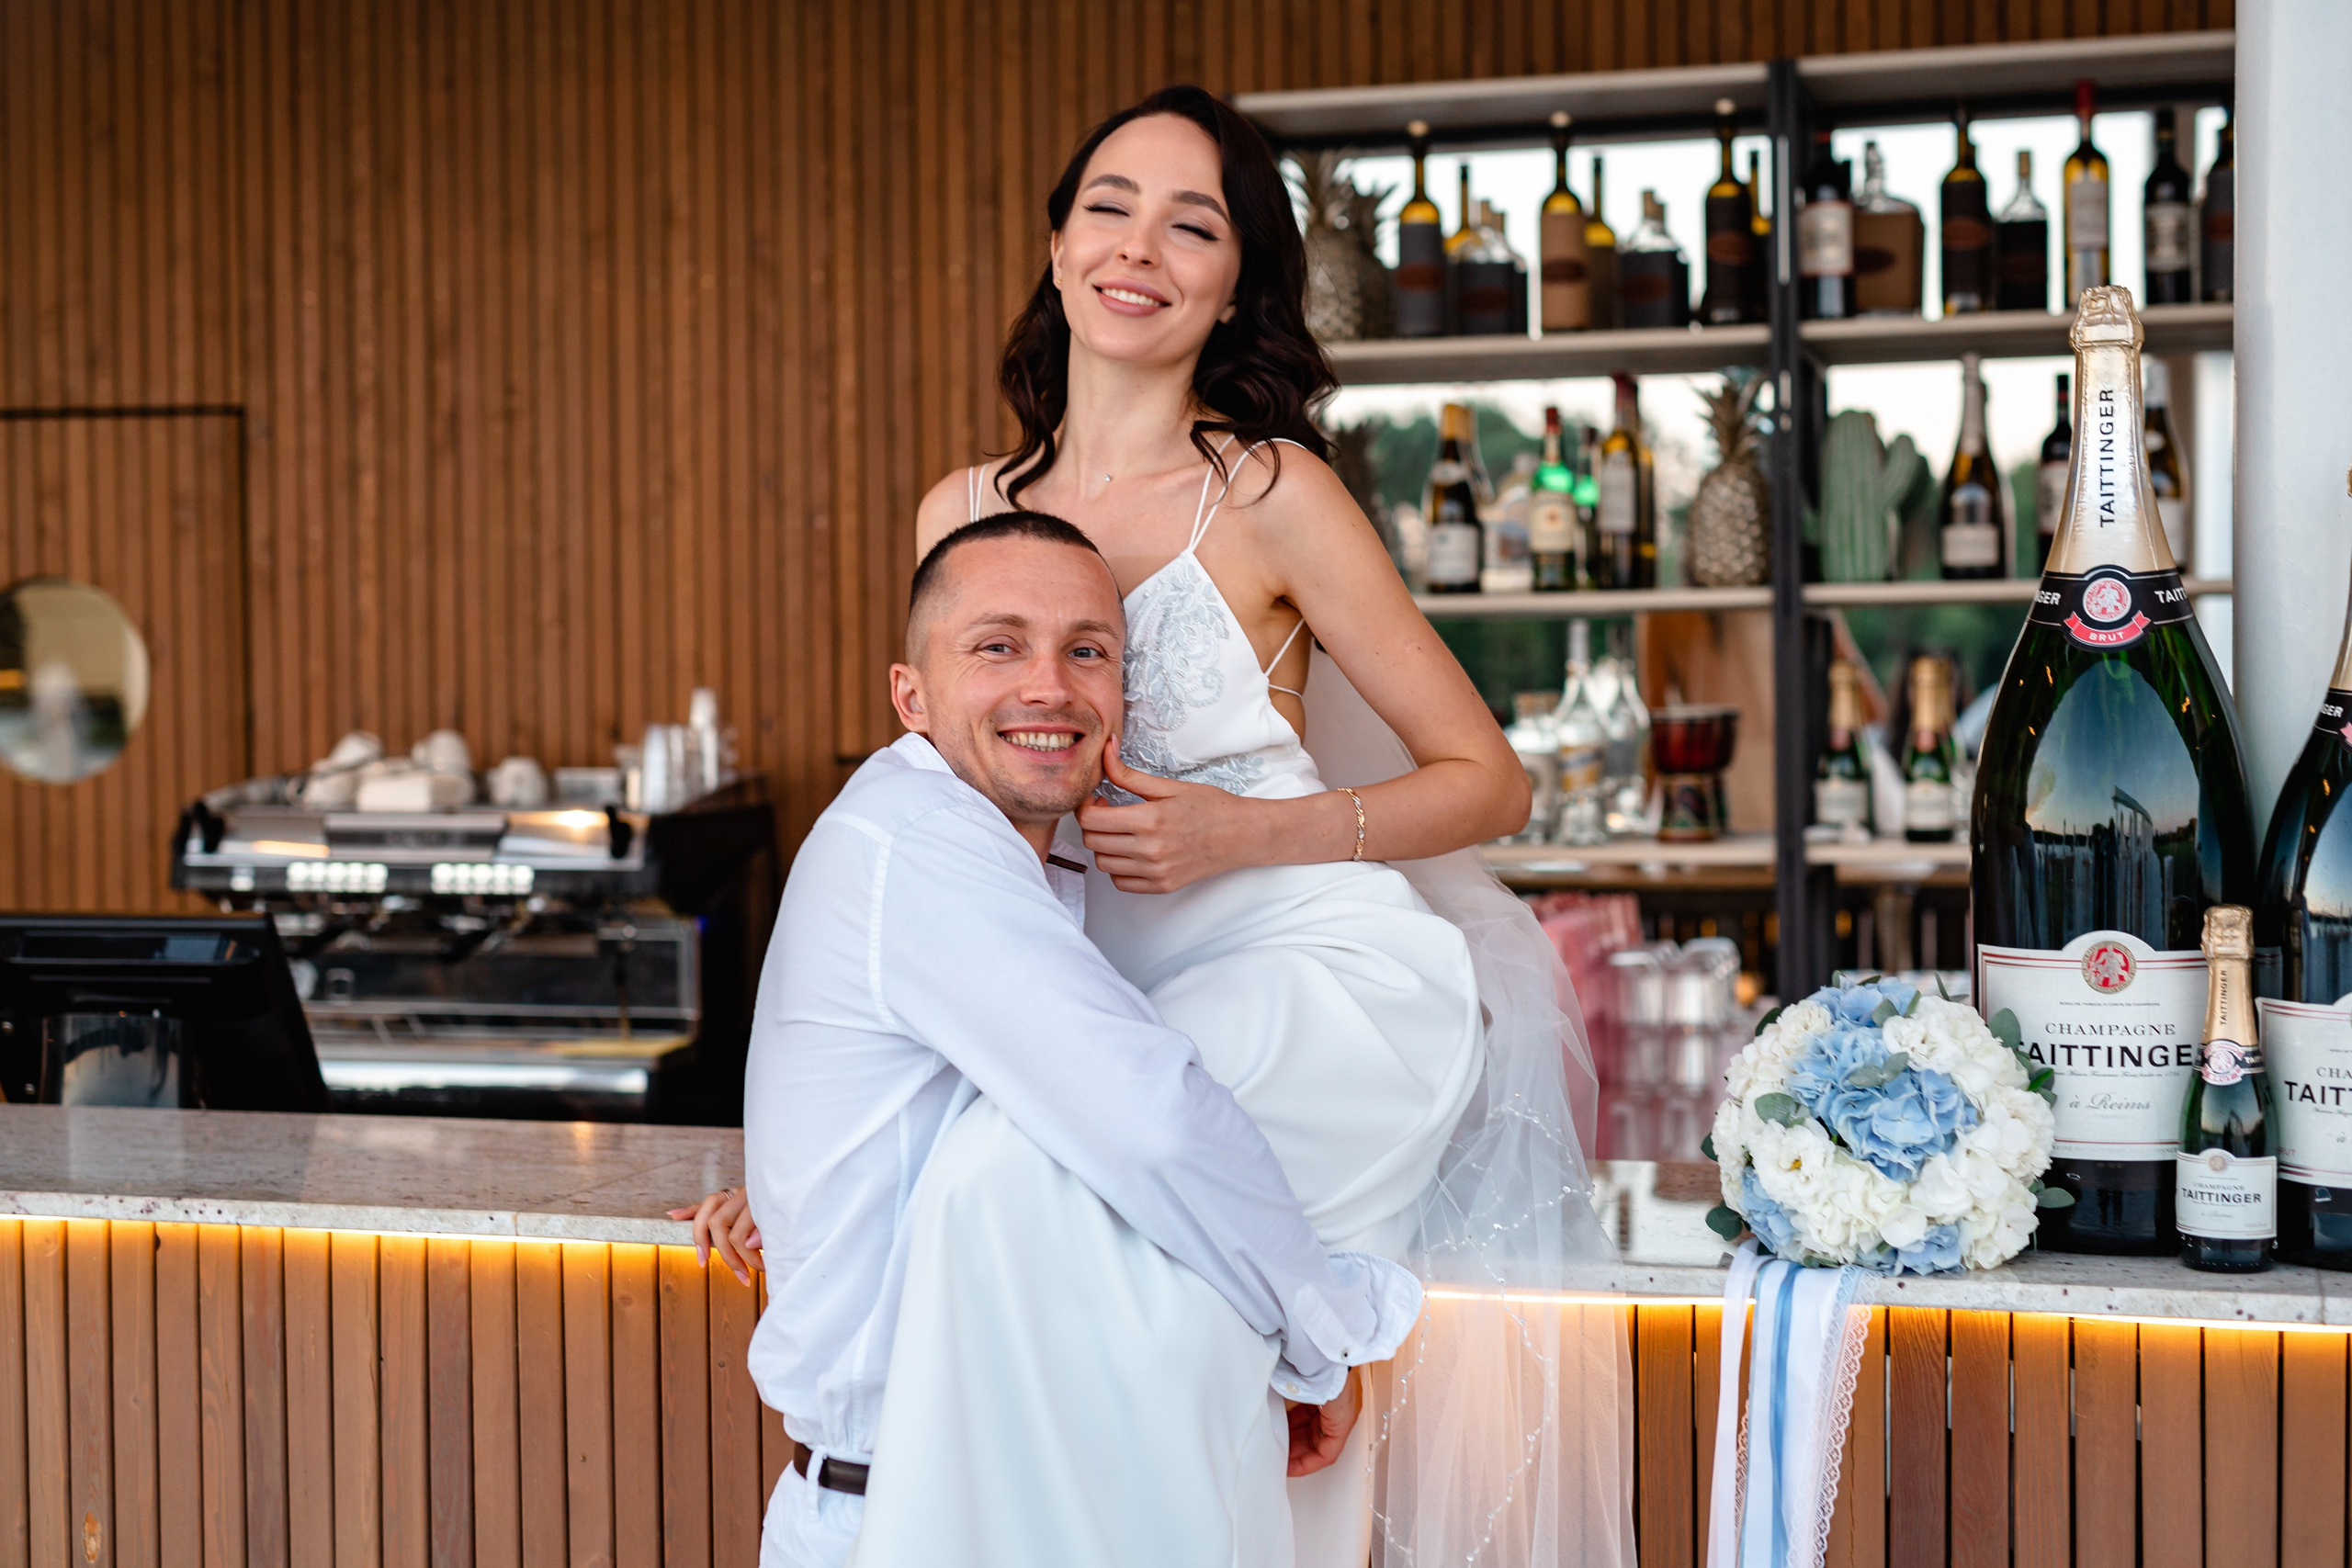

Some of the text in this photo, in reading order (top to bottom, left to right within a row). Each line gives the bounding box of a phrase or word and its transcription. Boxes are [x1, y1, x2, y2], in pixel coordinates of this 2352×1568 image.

[2099, 389, 2115, 527] TAITTINGER
[2088, 631, 2124, 642] BRUT
[2320, 703, 2344, 717] GER
[2219, 970, 2228, 1026] TAITTINGER
[2045, 1021, 2177, 1036] CHAMPAGNE
[2017, 1041, 2193, 1068] AITTINGE
[2069, 1091, 2151, 1111] à Reims
[2284, 1080, 2352, 1107] TAIT
[2192, 1181, 2245, 1191] CHAMPAGNE
[2181, 1187, 2262, 1204] TAITTINGER
